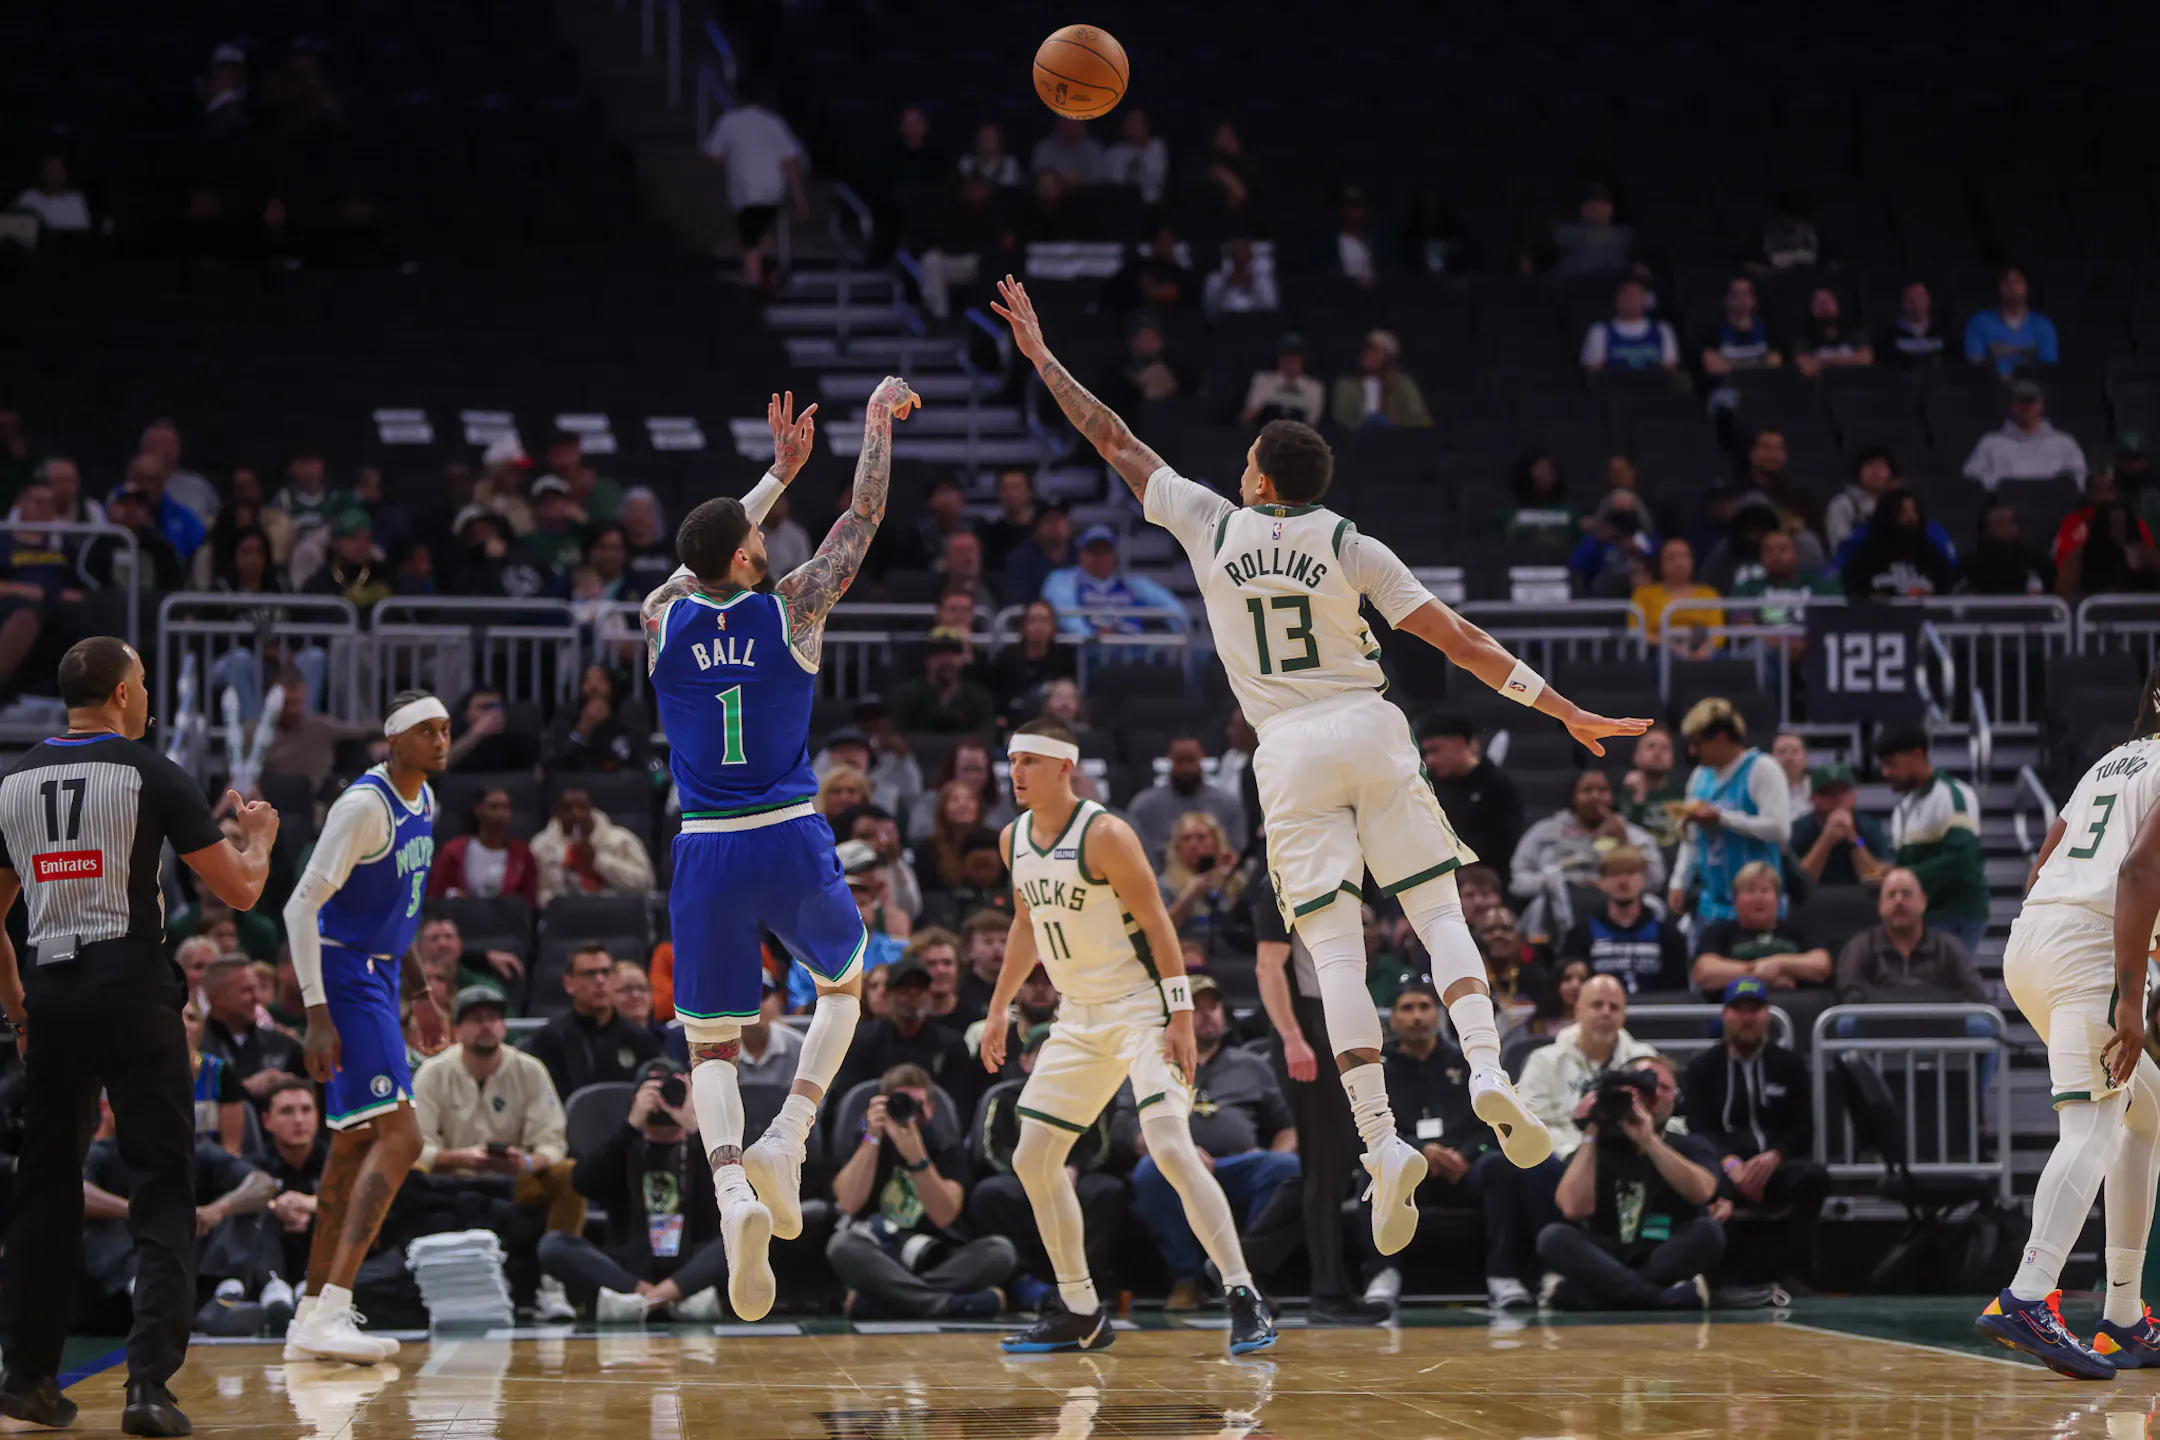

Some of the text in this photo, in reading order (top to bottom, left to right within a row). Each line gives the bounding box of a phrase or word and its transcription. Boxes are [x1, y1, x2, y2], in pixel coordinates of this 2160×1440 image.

[1224, 547, 1328, 589] ROLLINS
[691, 636, 756, 671] BALL
[1246, 595, 1321, 675] 13
[1823, 632, 1906, 693] 122
[714, 684, 748, 765] 1
[40, 778, 86, 842] 17
[2066, 792, 2118, 860] 3
[40, 859, 97, 875] Emirates
[405, 871, 426, 918] 3
[1043, 921, 1071, 960] 11
[1171, 987, 1185, 1002] 11
